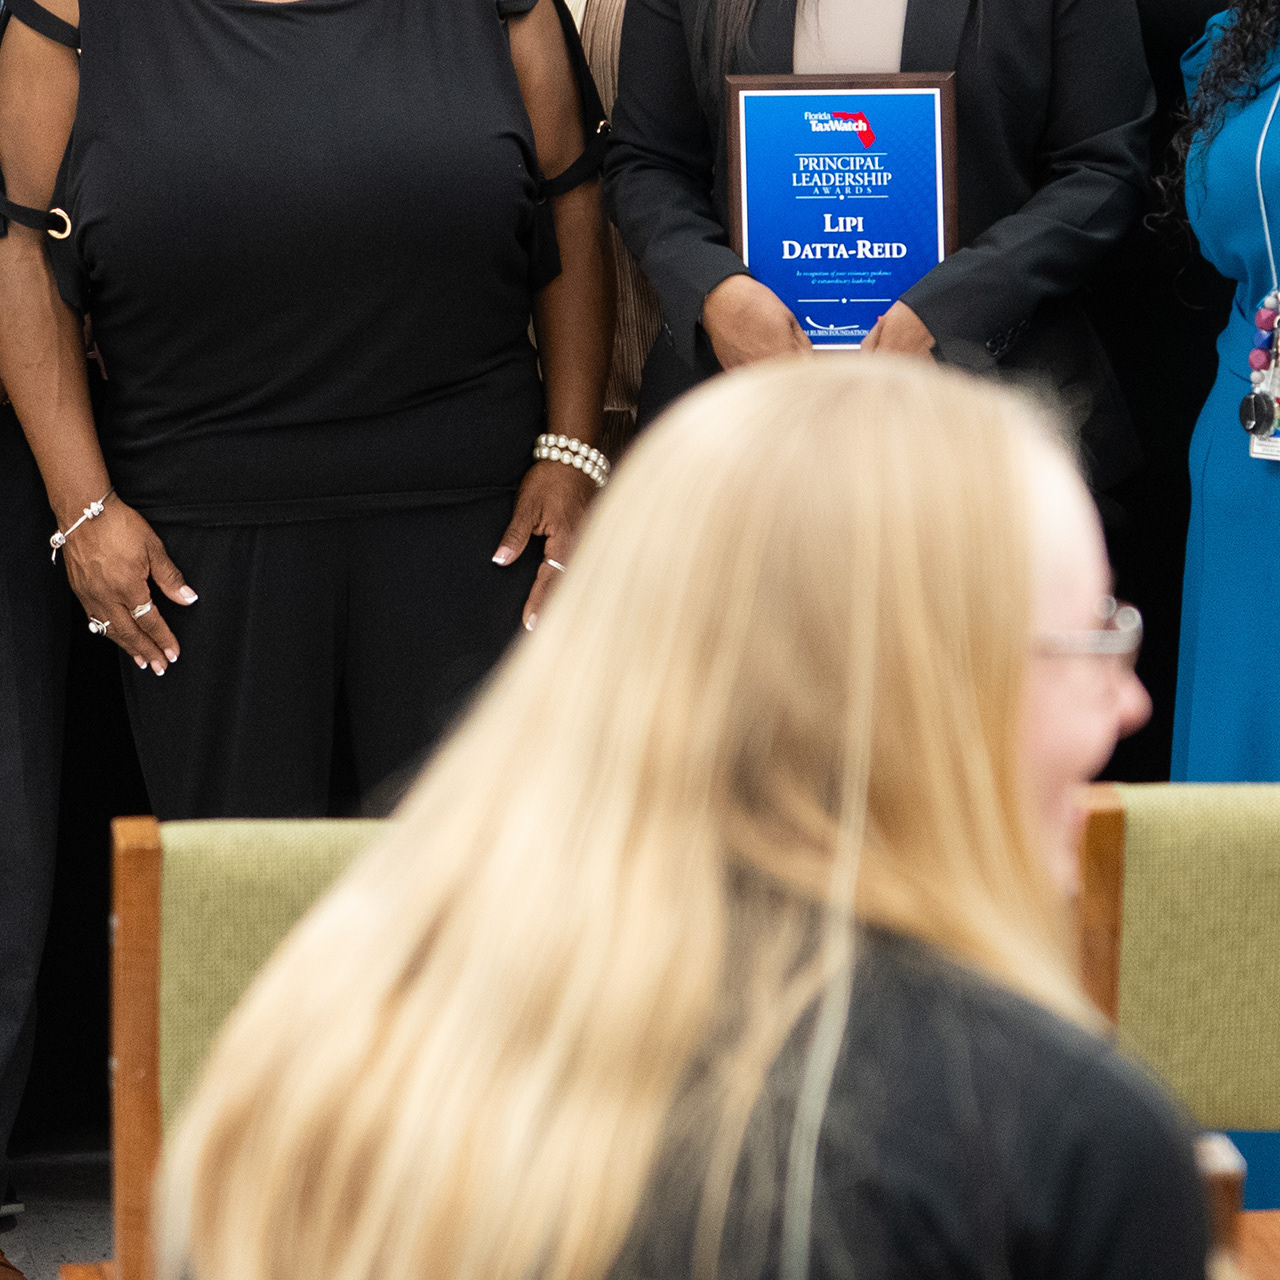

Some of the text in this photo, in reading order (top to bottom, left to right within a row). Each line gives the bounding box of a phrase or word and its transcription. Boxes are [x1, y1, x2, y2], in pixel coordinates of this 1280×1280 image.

[804, 111, 831, 120] Florida
[809, 119, 867, 132] TaxWatch
[798, 156, 884, 171] PRINCIPAL
[792, 172, 892, 186] LEADERSHIP
[813, 187, 872, 195] AWARDS
[829, 328, 870, 336] FOUNDATION
